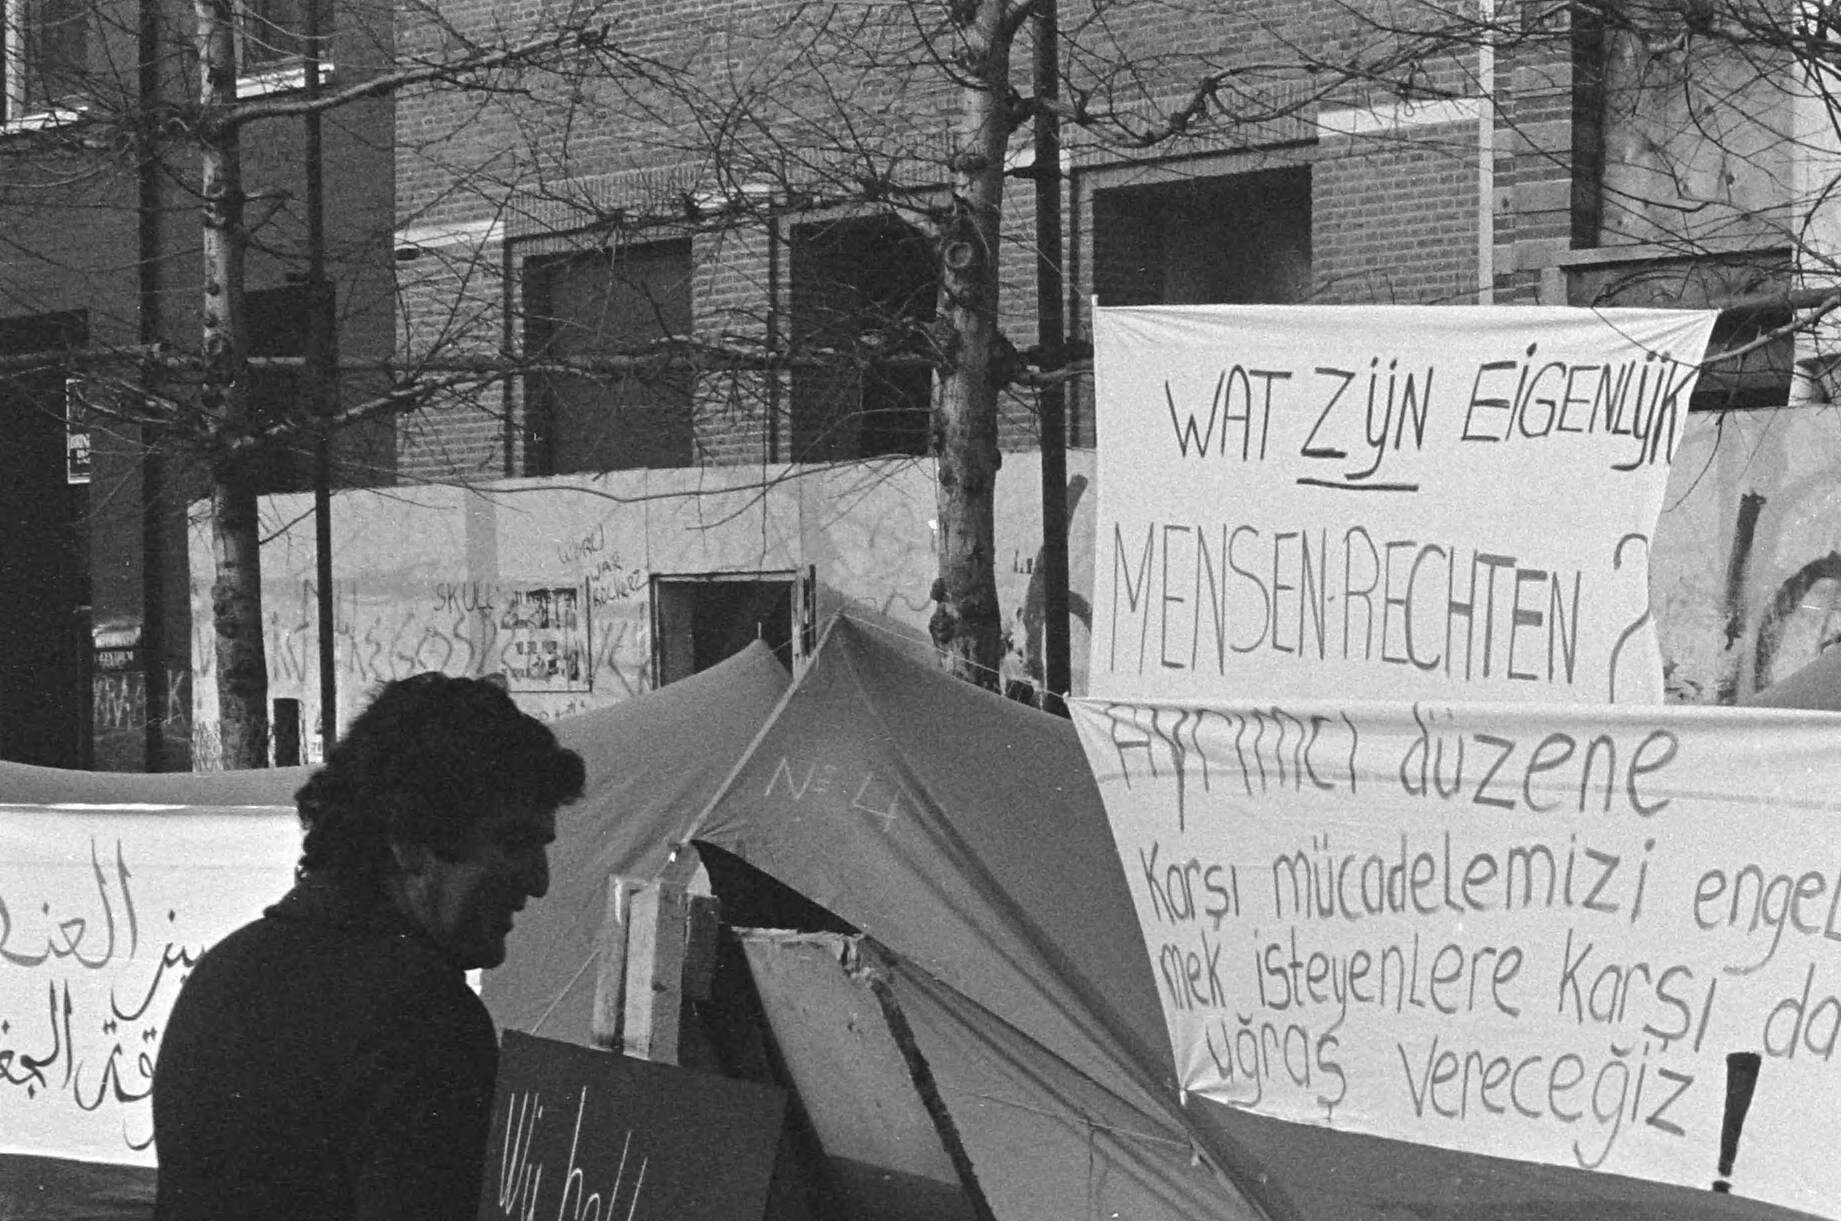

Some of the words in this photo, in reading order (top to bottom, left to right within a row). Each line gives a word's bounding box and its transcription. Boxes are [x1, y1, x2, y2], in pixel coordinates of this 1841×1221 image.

[1164, 363, 1293, 461] WAT
[1399, 702, 1679, 818] düzene
[1272, 832, 1657, 923] mücadelemizi
[1159, 929, 1226, 1011] mek
[1253, 927, 1524, 1034] isteyenlere
[1206, 1013, 1346, 1124] uğraş
